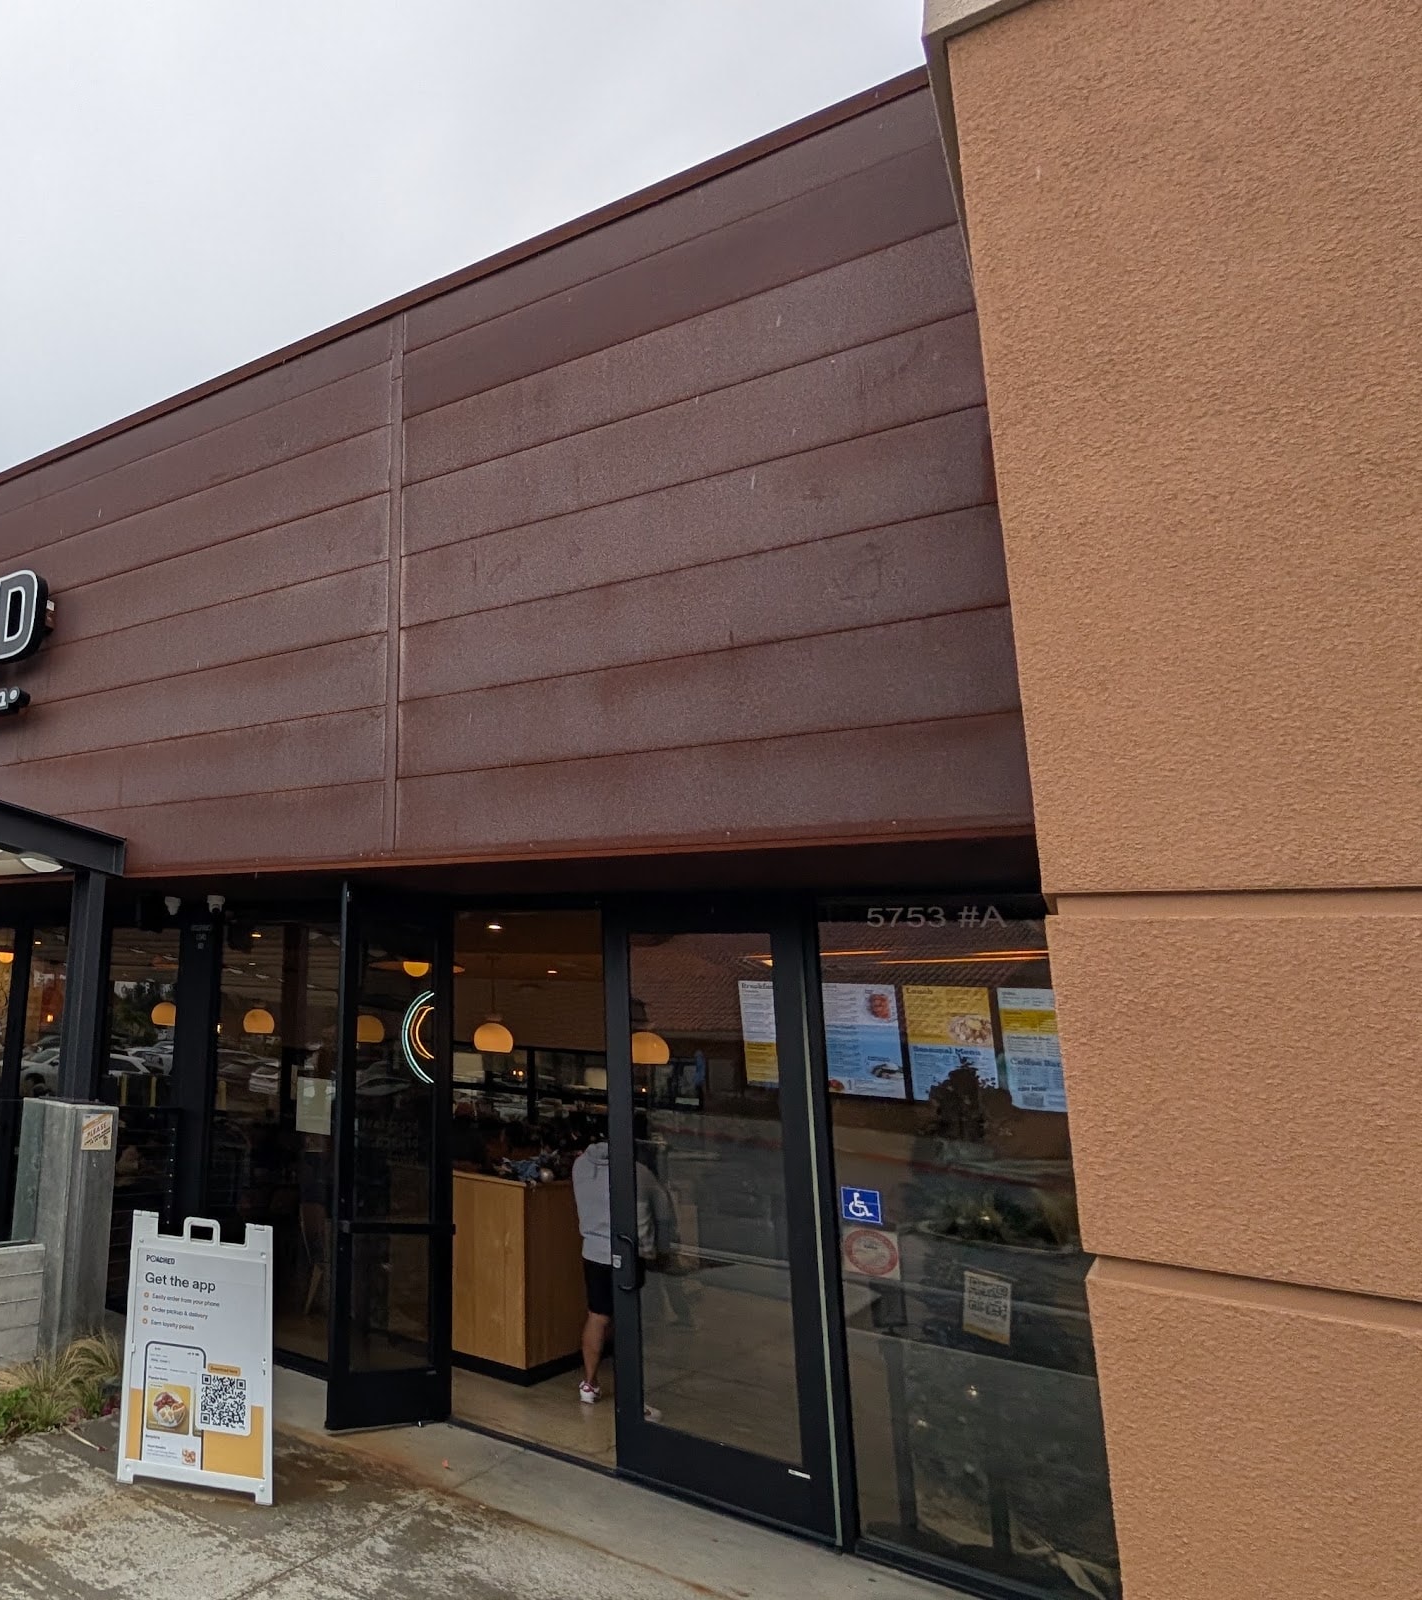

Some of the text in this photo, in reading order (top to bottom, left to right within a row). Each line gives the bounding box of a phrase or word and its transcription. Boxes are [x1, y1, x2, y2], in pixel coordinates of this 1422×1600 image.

[867, 905, 1008, 927] 5753 #A
[145, 1272, 216, 1294] Get the app
[204, 1299, 220, 1308] phone
[166, 1308, 184, 1316] pickup
[188, 1311, 208, 1320] delivery
